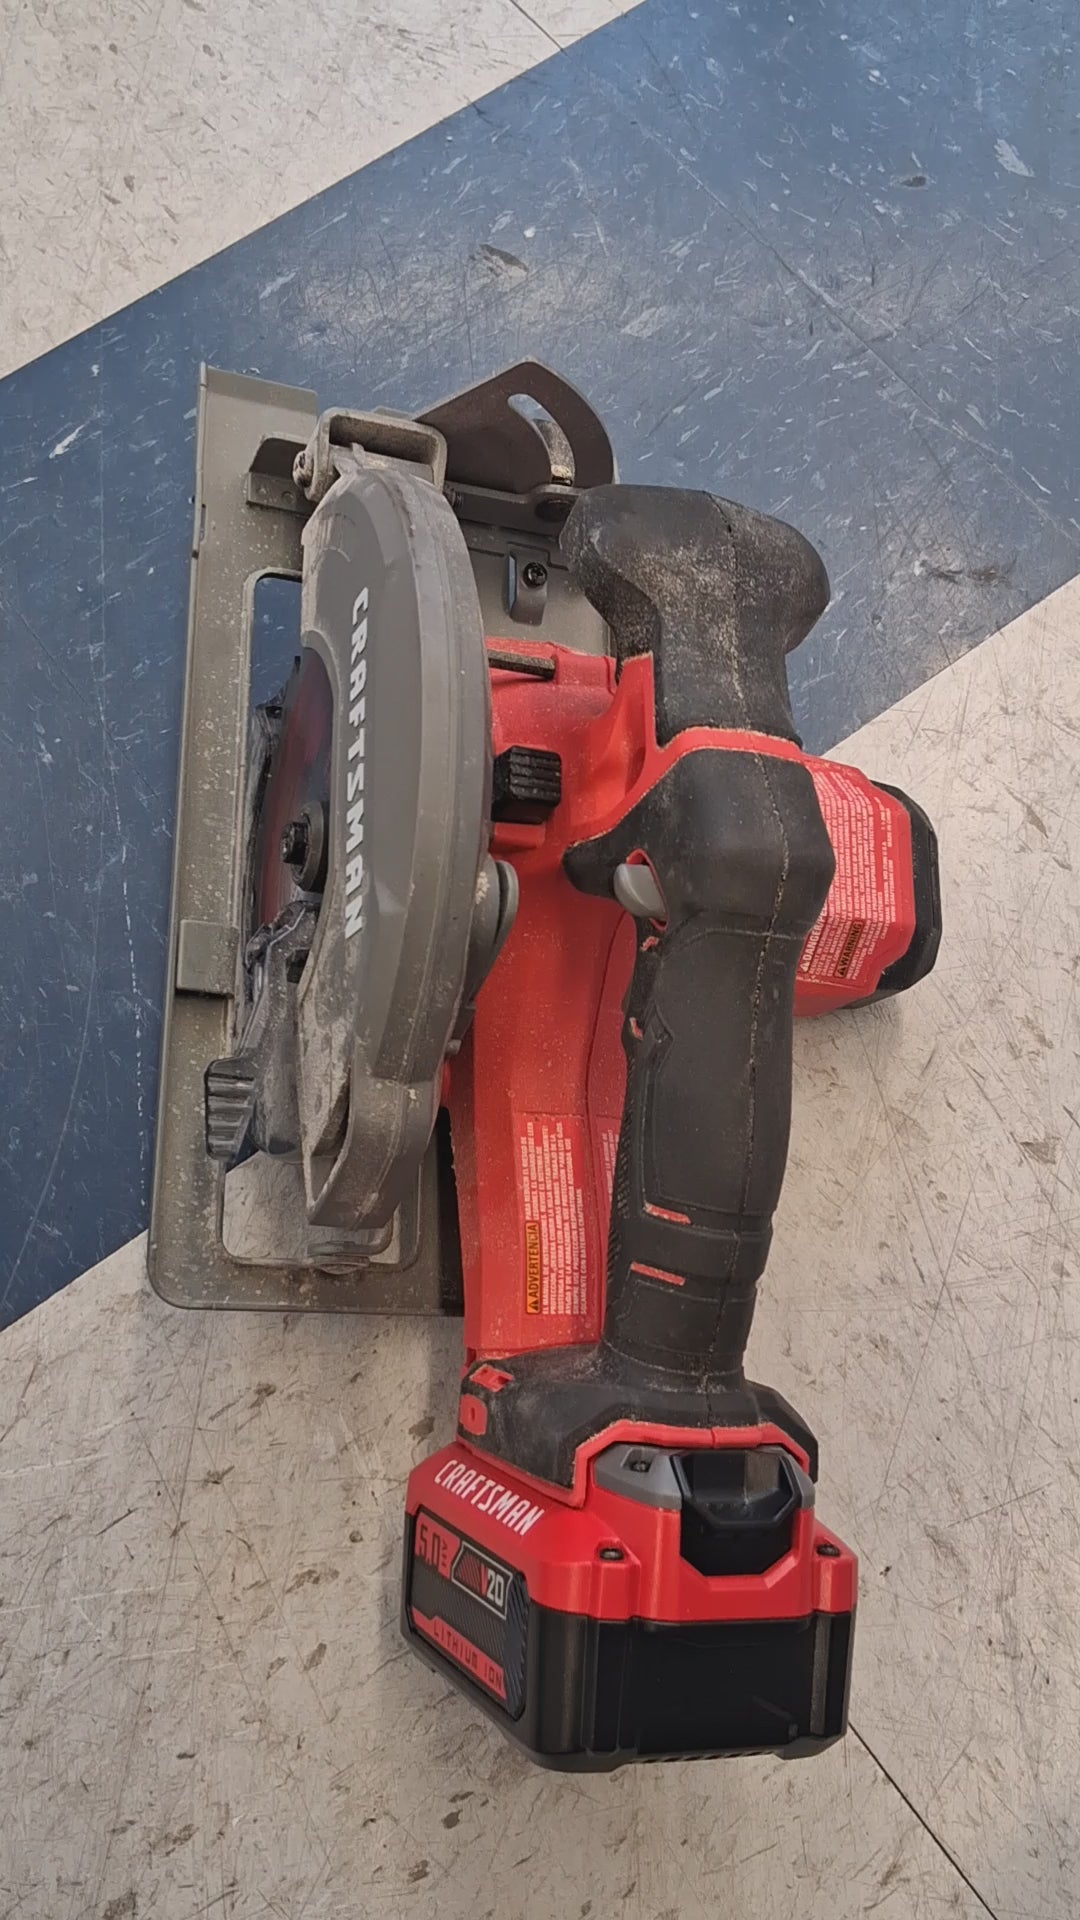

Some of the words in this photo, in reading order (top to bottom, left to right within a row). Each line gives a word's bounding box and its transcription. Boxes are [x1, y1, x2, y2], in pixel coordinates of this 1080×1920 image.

[345, 586, 369, 939] CRAFTSMAN
[839, 924, 861, 966] WARNING
[867, 922, 882, 954] CRAFTSMAN
[528, 1224, 538, 1298] ADVERTENCIA
[434, 1459, 544, 1536] CRAFTSMAN
[419, 1524, 440, 1571] 5.0
[479, 1562, 505, 1608] V20
[433, 1622, 478, 1671] LITHIUM
[484, 1662, 503, 1691] ION
